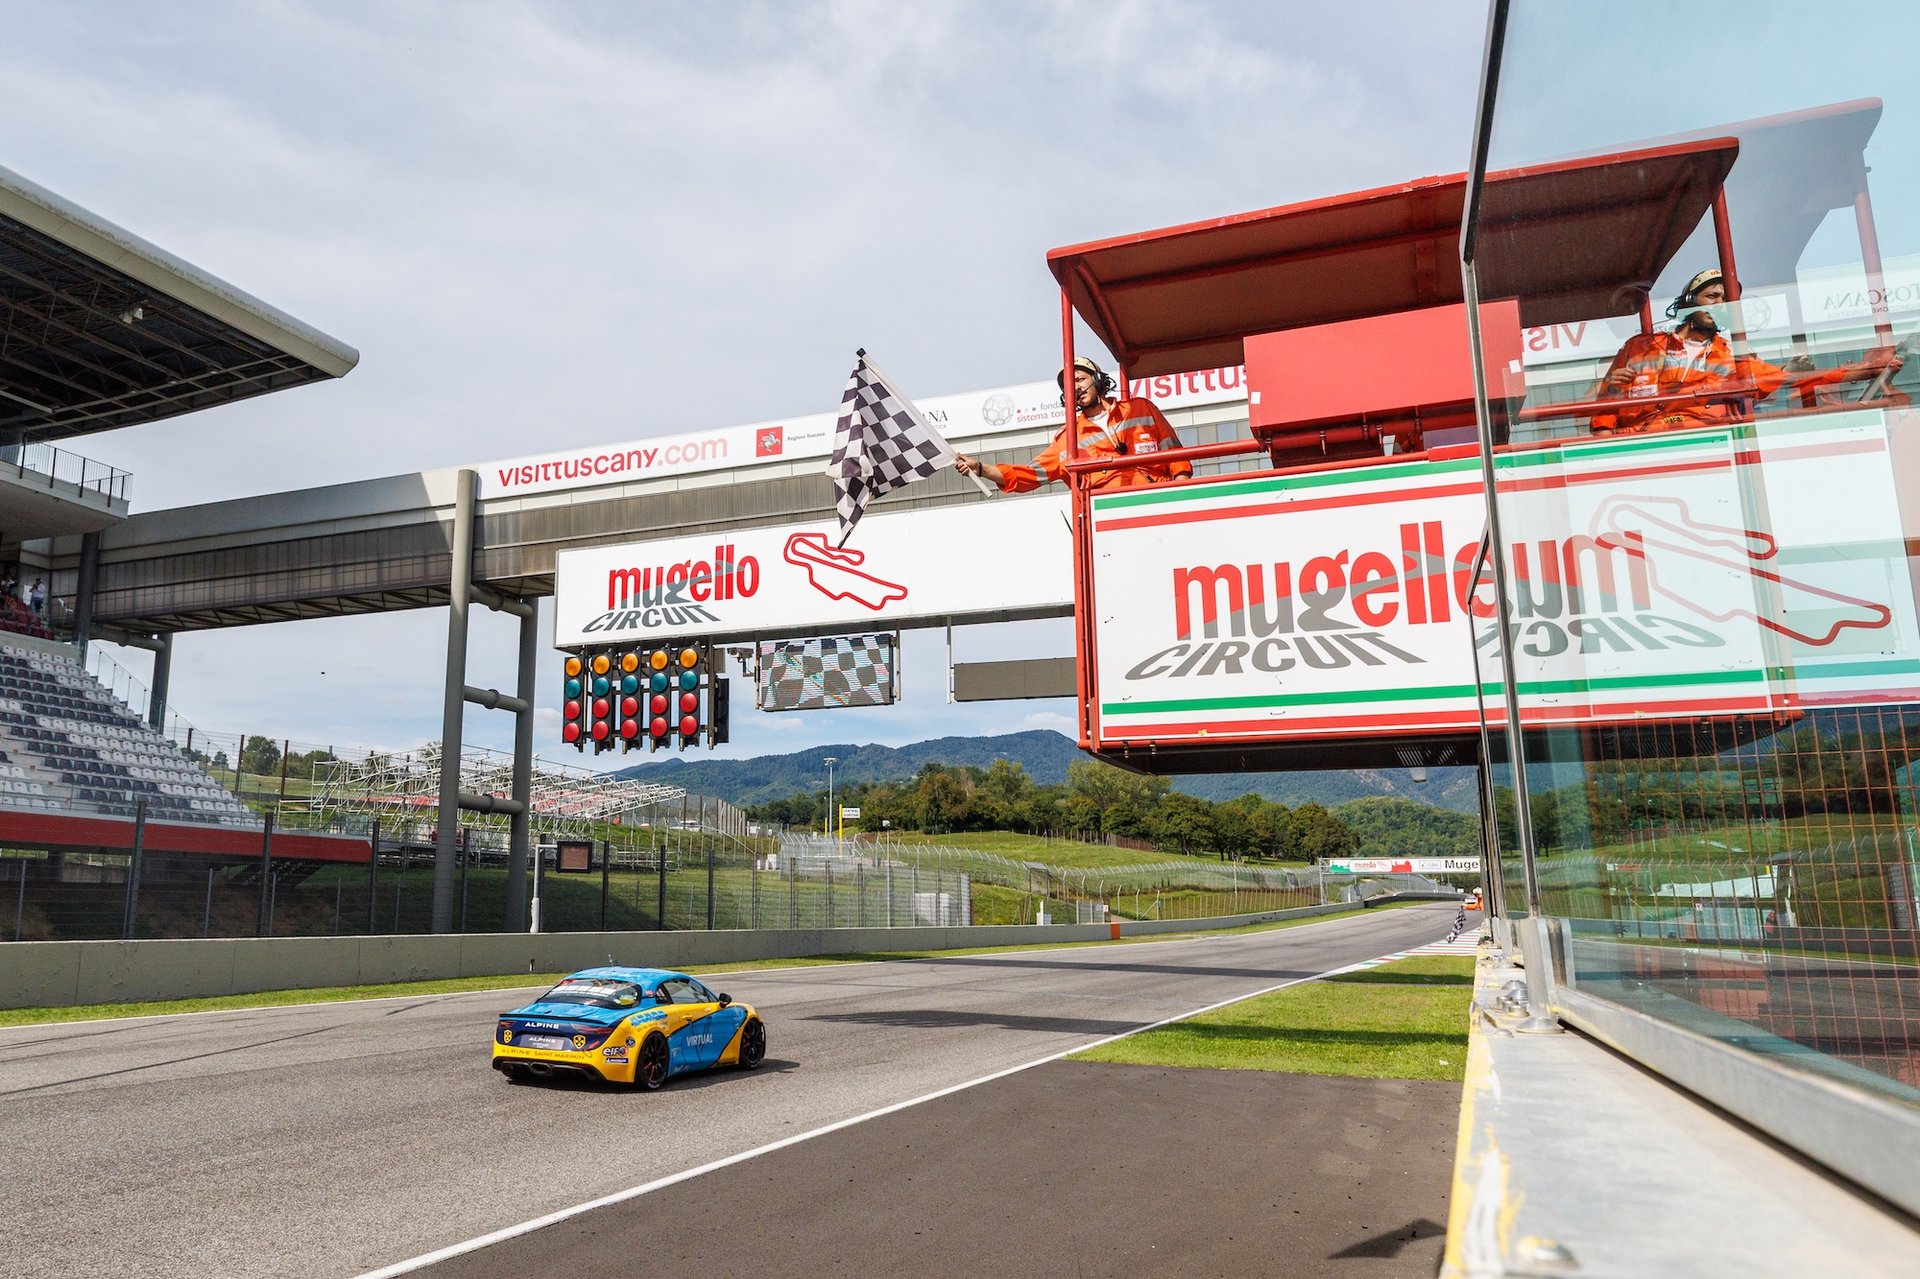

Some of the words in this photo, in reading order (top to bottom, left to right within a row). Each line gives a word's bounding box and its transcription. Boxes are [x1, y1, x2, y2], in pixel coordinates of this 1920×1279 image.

[608, 544, 760, 611] mugello
[582, 605, 721, 633] CIRCUIT
[1125, 631, 1429, 680] CIRCUIT
[529, 1036, 556, 1044] ALPINE
[686, 1033, 713, 1046] VIRTUAL
